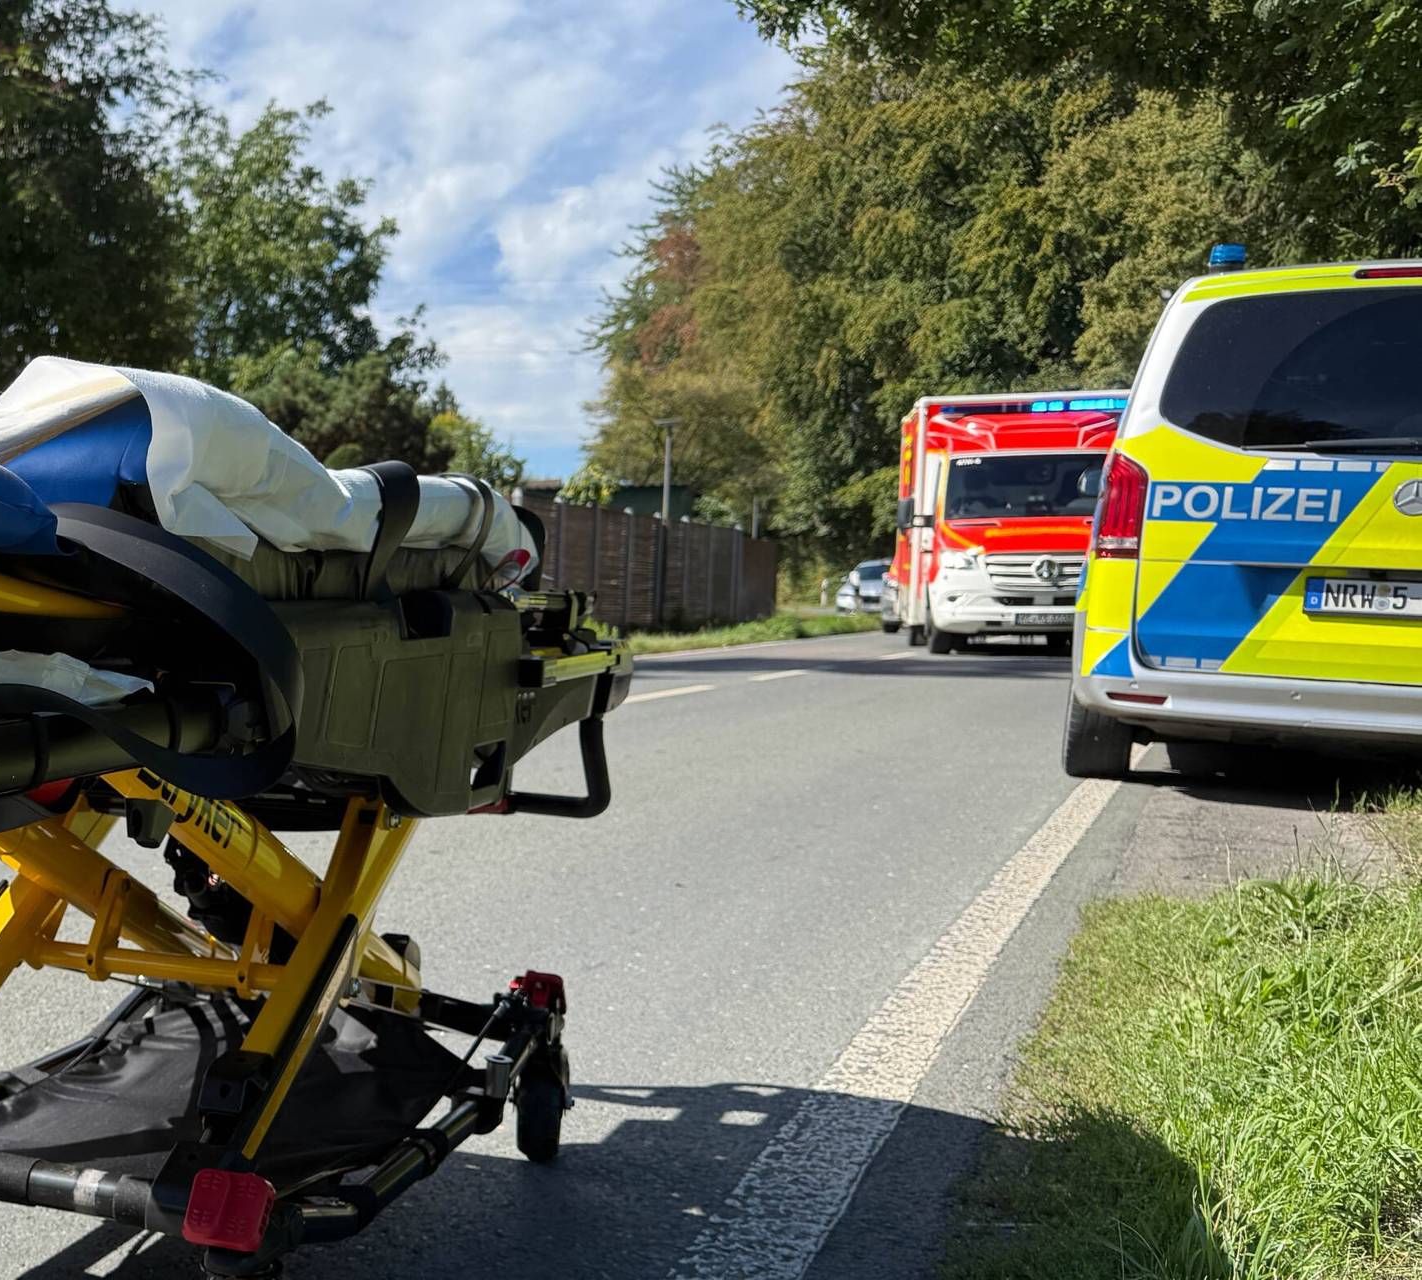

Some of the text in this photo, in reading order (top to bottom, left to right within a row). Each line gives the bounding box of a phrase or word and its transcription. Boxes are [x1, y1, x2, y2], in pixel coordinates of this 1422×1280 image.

[1152, 485, 1342, 523] POLIZEI
[1324, 583, 1376, 608] NRW
[137, 768, 242, 848] yker
